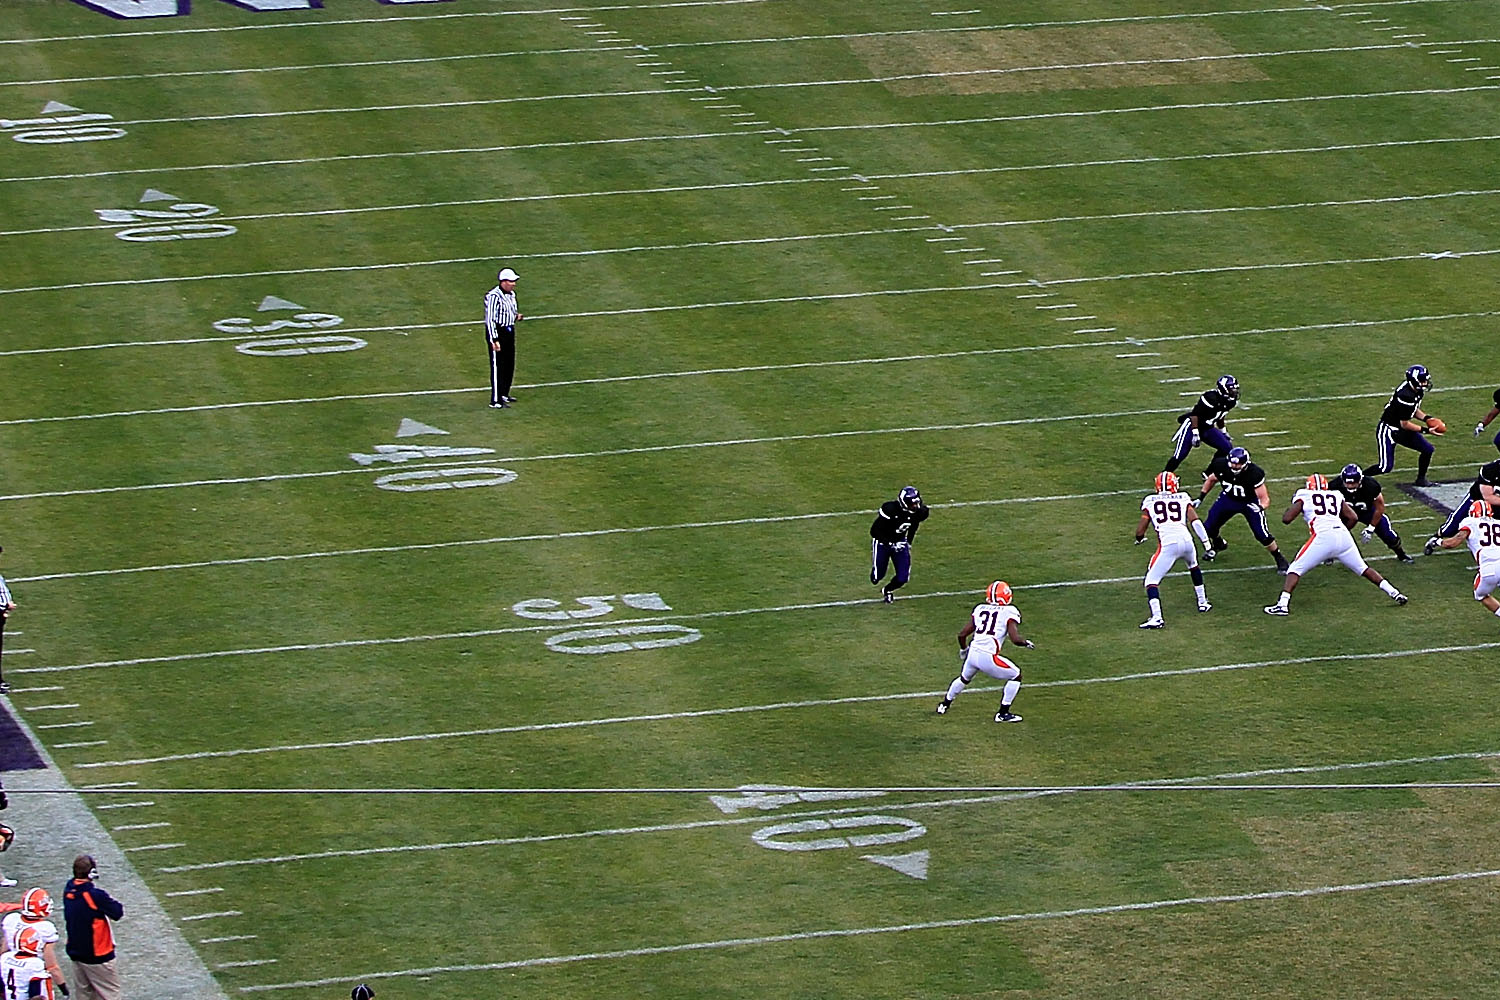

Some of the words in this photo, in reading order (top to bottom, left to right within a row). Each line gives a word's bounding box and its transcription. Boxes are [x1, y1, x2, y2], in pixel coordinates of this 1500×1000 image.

[1153, 500, 1182, 524] 99
[1312, 493, 1338, 517] 93
[975, 610, 999, 636] 31
[7, 968, 17, 999] 4
